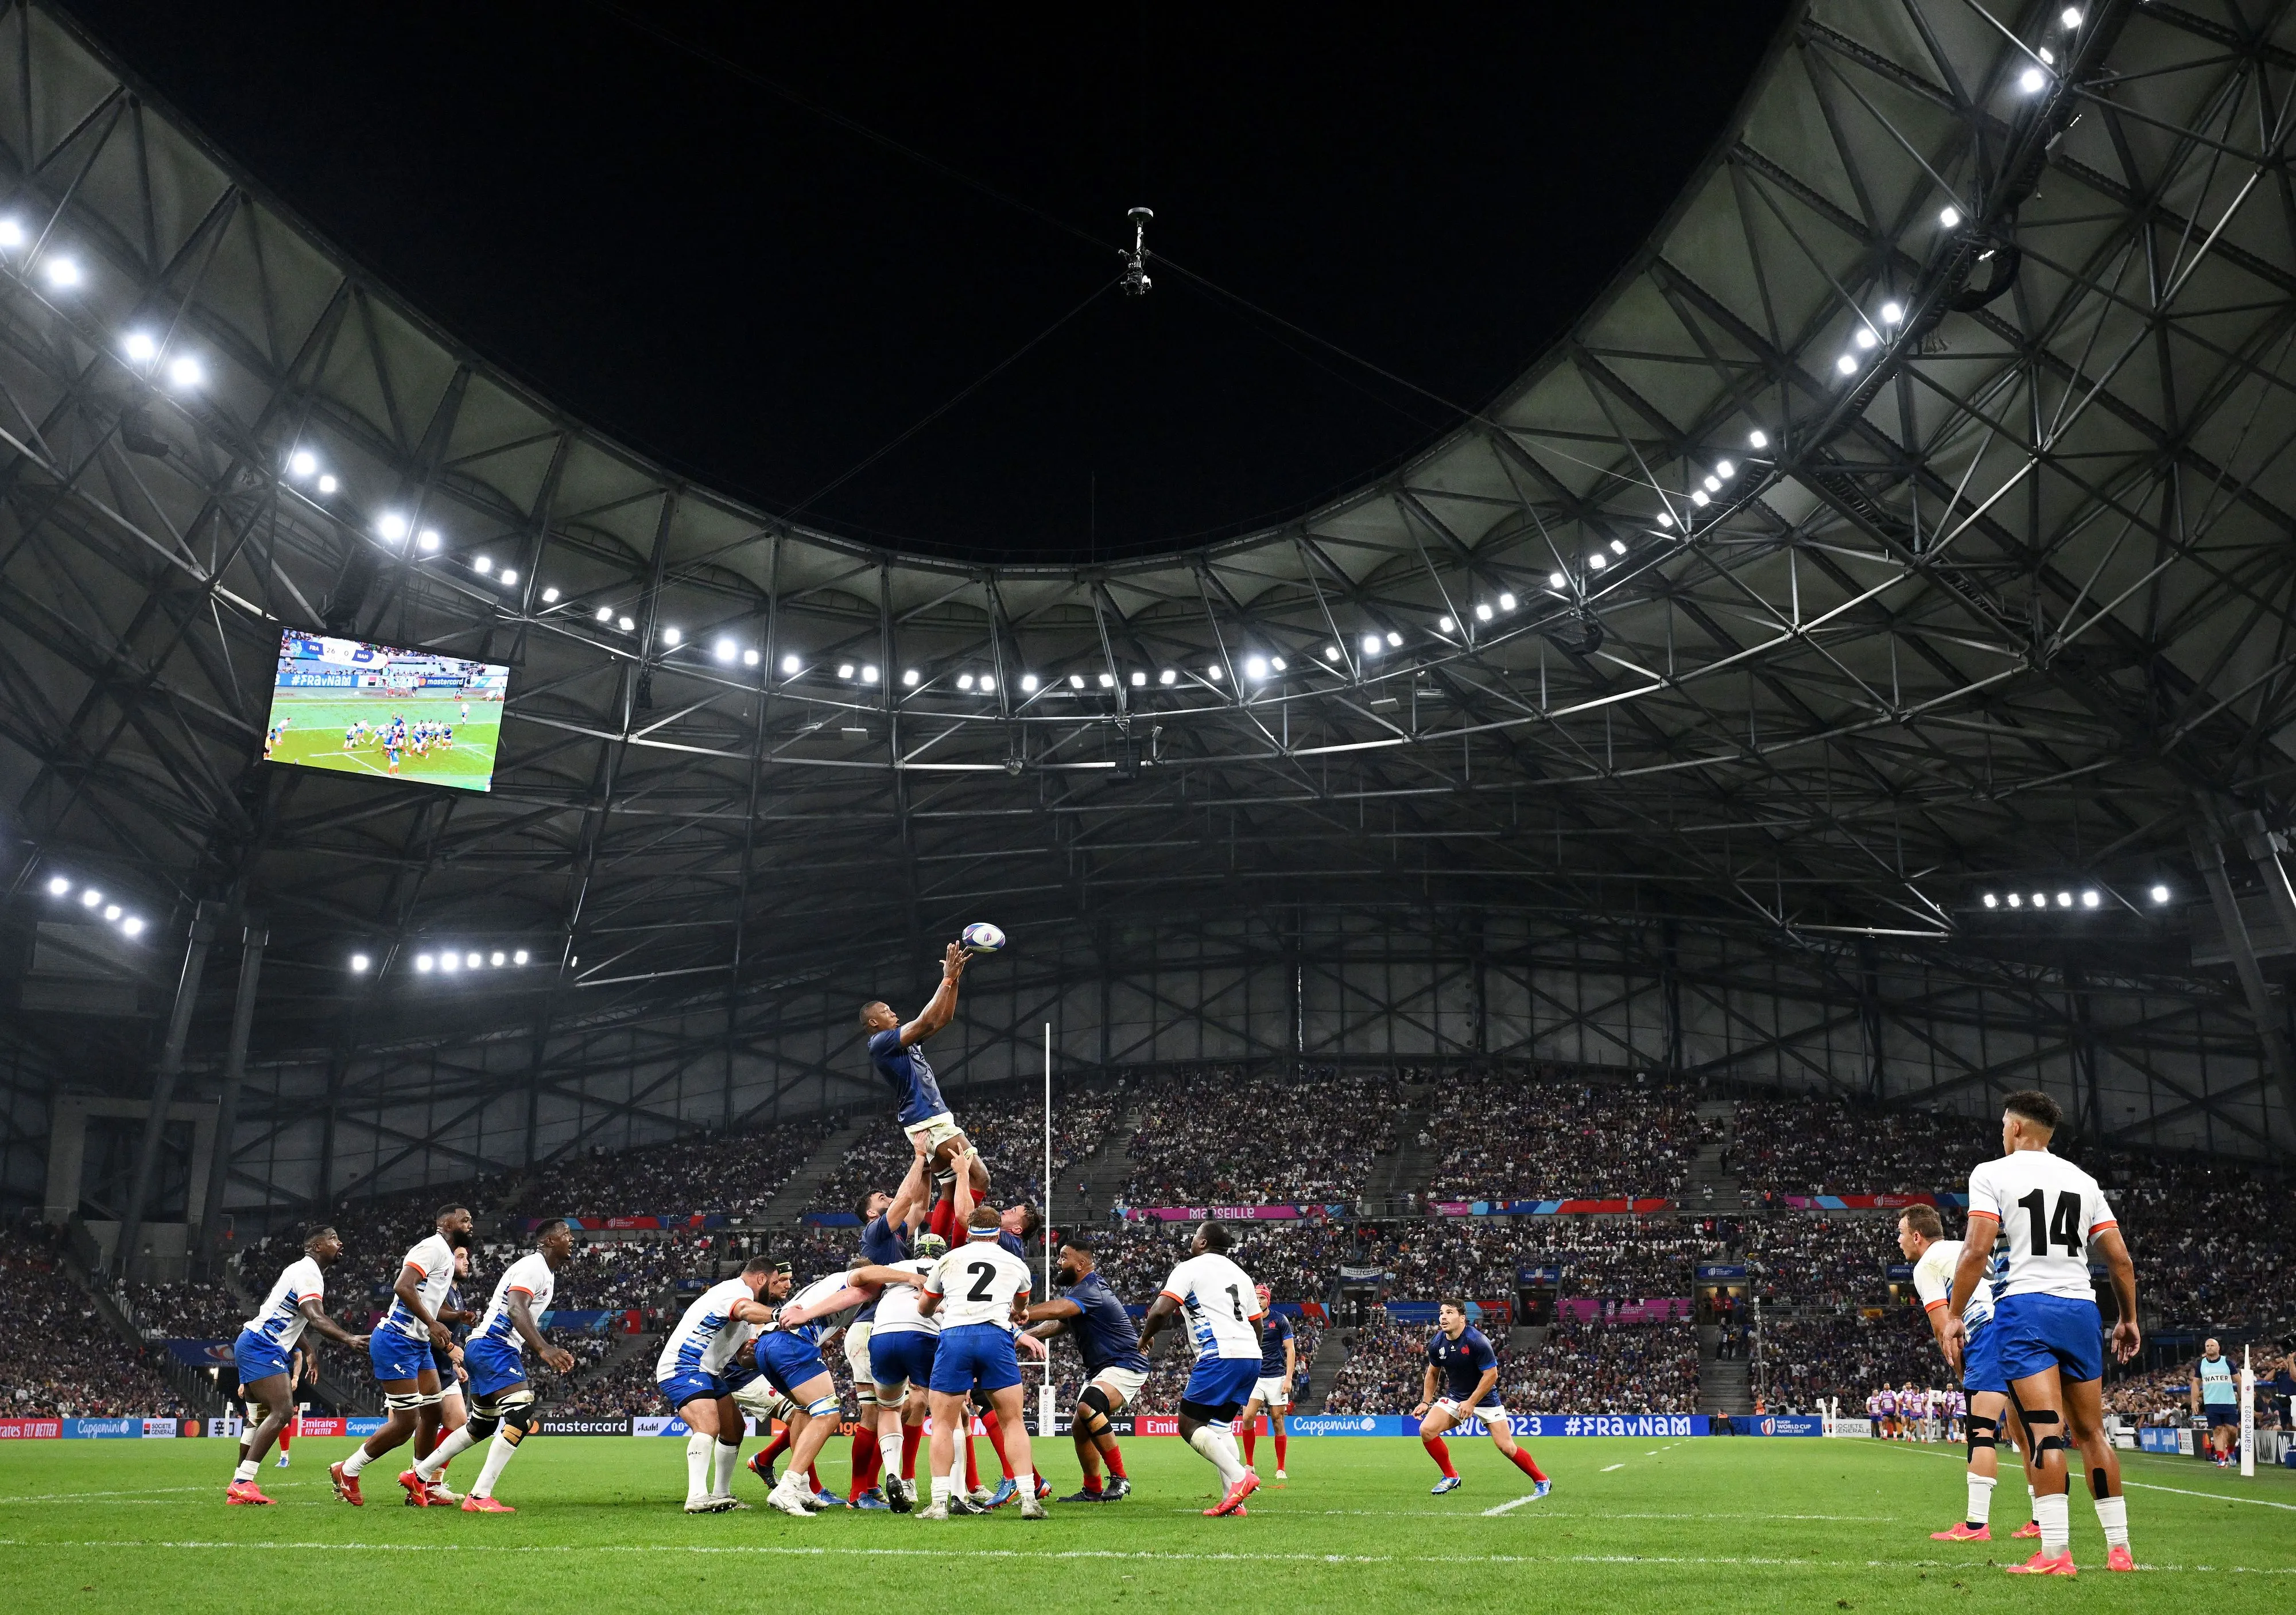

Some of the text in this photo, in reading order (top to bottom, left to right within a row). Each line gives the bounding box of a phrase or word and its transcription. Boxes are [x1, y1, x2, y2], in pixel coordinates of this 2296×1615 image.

[427, 677, 463, 685] mastercard
[2018, 1189, 2084, 1257] 14
[967, 1262, 996, 1302] 2
[1225, 1284, 1243, 1322] 1
[393, 1363, 406, 1375] BLK
[509, 1367, 522, 1377] BLK
[689, 1378, 703, 1387] BLK
[0, 1423, 57, 1437] rates FLY BETTER
[77, 1420, 120, 1439] Capgemini
[301, 1420, 338, 1428] Emirates
[544, 1420, 627, 1432] mastercard
[1293, 1416, 1360, 1436] Capgemini
